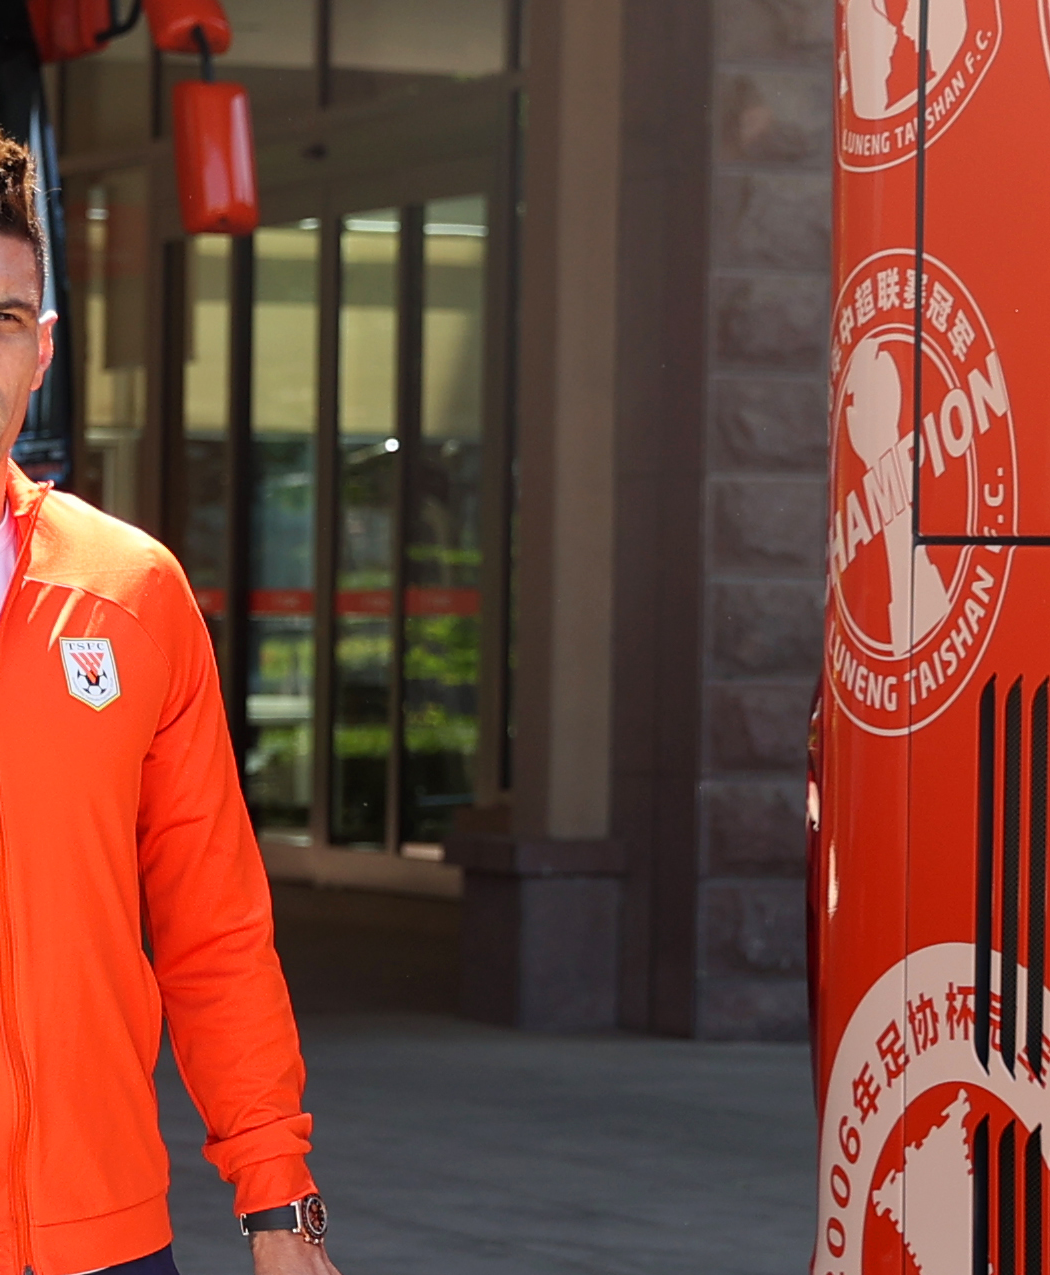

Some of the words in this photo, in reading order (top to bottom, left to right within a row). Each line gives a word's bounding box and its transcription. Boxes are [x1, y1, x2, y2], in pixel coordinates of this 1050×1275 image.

[842, 128, 891, 156] LUNENG
[826, 351, 1009, 574] HAMPION
[828, 620, 898, 712] LUNENG
[903, 564, 996, 706] TAISHAN
